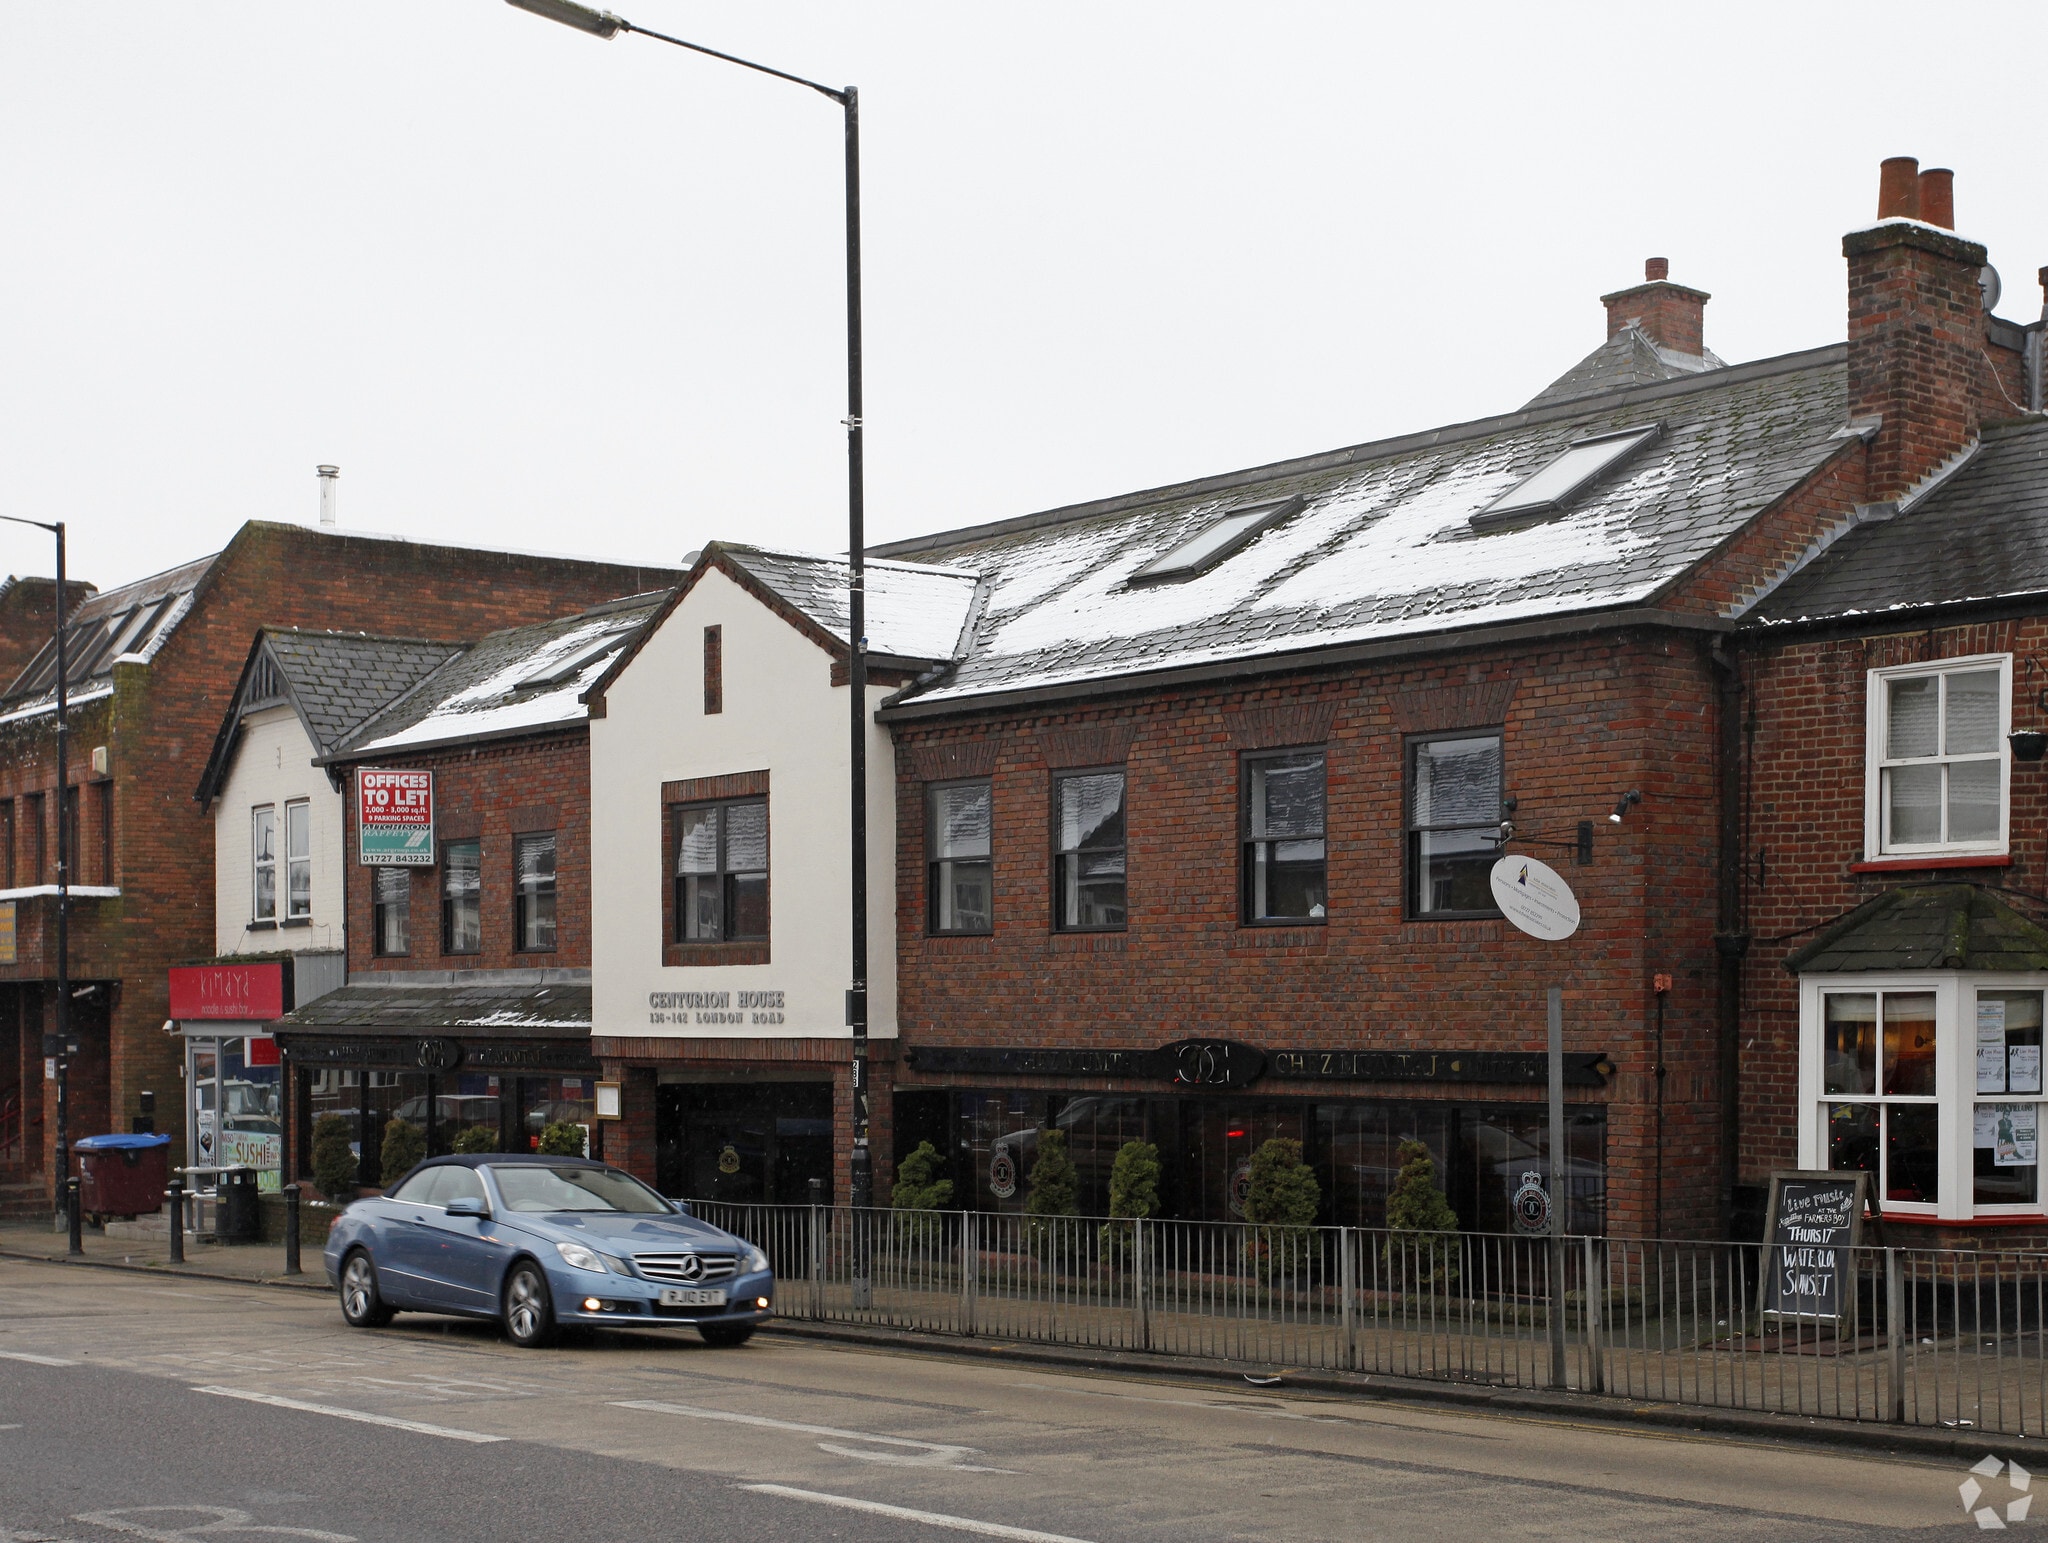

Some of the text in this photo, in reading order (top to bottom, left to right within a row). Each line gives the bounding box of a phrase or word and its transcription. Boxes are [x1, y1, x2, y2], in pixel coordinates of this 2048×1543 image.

[364, 774, 428, 788] OFFICES
[364, 789, 428, 806] TO LET
[390, 806, 410, 814] 3,000
[363, 855, 431, 863] 01727 843232
[649, 991, 785, 1009] CENTURION HOUSE
[202, 1003, 219, 1014] noodle
[224, 1003, 238, 1014] sushi
[695, 1012, 743, 1024] LONDON
[752, 1012, 785, 1024] ROAD
[236, 1142, 266, 1165] SUSHI
[1804, 1213, 1832, 1225] FARMERS
[1833, 1213, 1847, 1225] BOY
[1787, 1226, 1822, 1244] THURS
